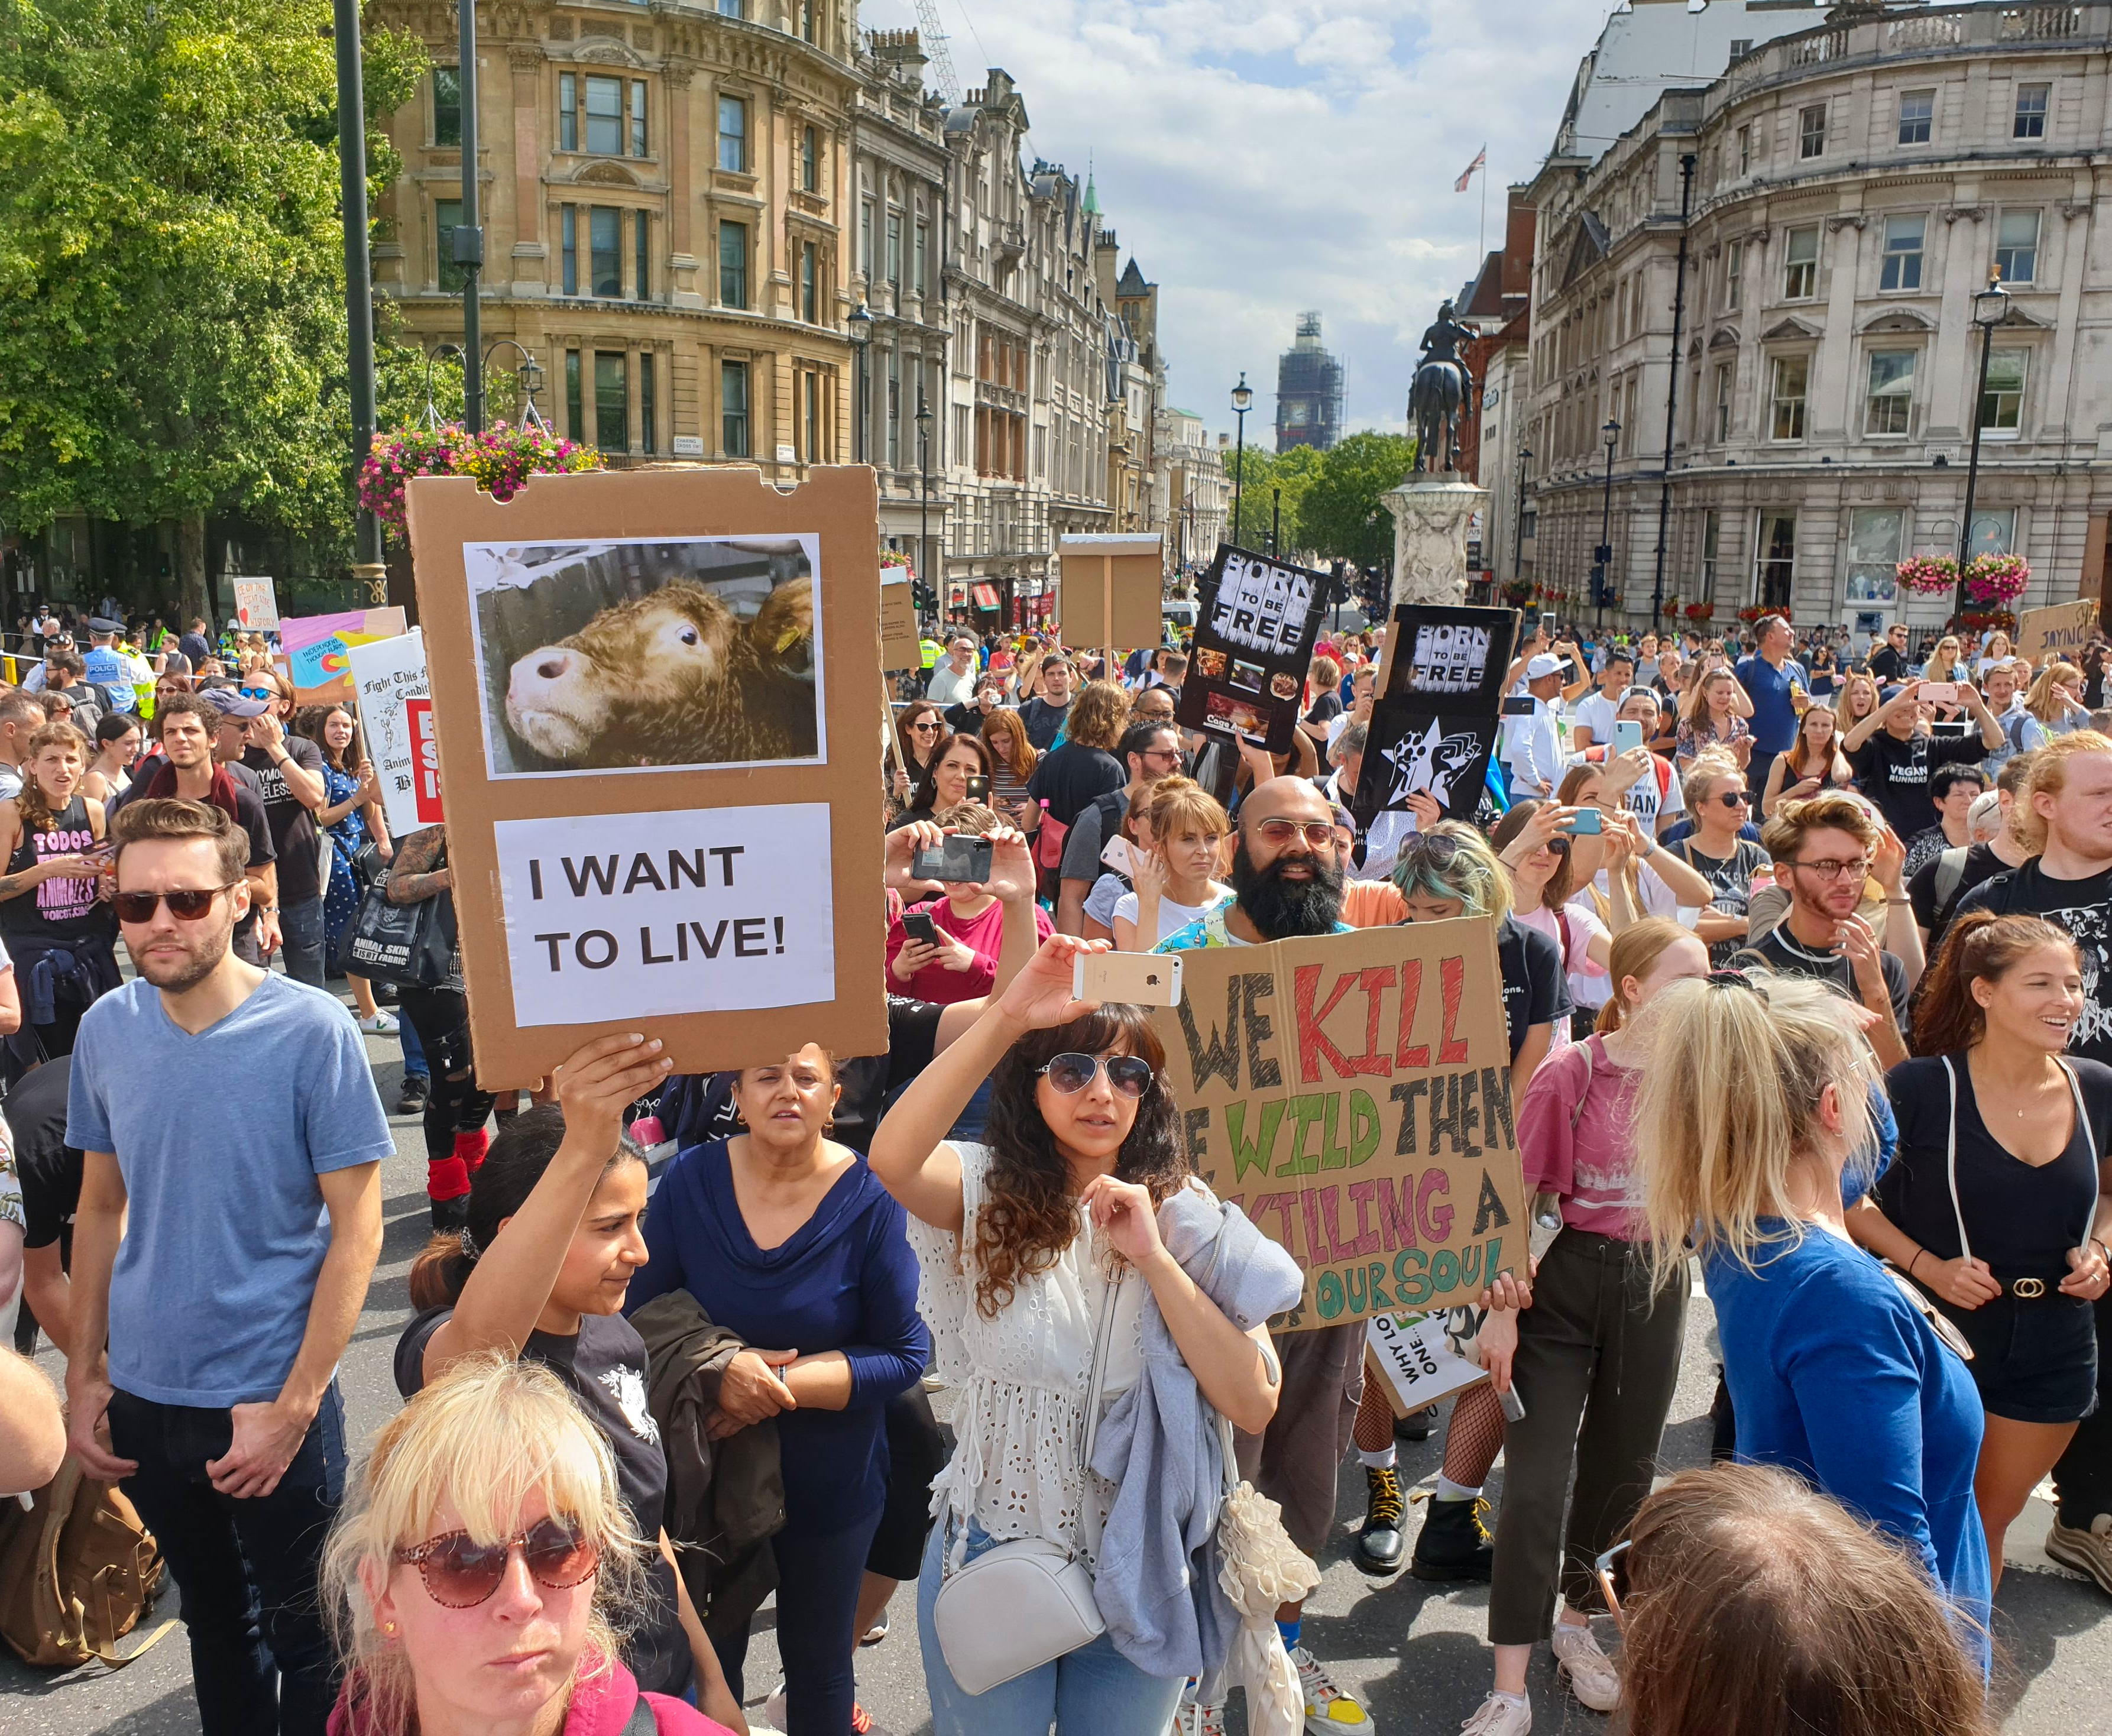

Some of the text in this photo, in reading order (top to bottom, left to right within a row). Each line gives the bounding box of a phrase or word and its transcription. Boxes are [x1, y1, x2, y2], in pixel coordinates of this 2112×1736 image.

[1222, 552, 1317, 600] BORN
[246, 583, 253, 592] ON
[255, 582, 266, 594] THE
[1241, 591, 1284, 613] TO BE
[250, 618, 275, 627] HISTORY
[1212, 601, 1302, 647] FREE
[1418, 624, 1491, 646] BORN
[302, 638, 339, 658] INDEPENDENT
[89, 665, 116, 673] POLICE
[1411, 665, 1483, 682] FREE
[363, 677, 391, 695] Fight
[393, 669, 417, 684] This
[1207, 714, 1230, 728] Cage
[1230, 722, 1249, 734] Age
[1889, 774, 1928, 783] RUNNERS
[1890, 764, 1928, 776] VEGAN
[33, 830, 94, 853] TODOS
[529, 845, 745, 901] I WANT
[354, 937, 410, 957] ANIMAL SKIN
[535, 916, 786, 973] TO LIVE!
[378, 954, 407, 966] FABRIC
[1179, 956, 1468, 1093] WE KILL
[1225, 1089, 1381, 1183] WILD
[1390, 1065, 1515, 1158] THEN
[1471, 1168, 1511, 1235] A
[1316, 1262, 1394, 1320] OUR
[1392, 1236, 1514, 1304] SOUL
[1409, 1327, 1437, 1375] ONE...
[1388, 1345, 1420, 1385] WHY
